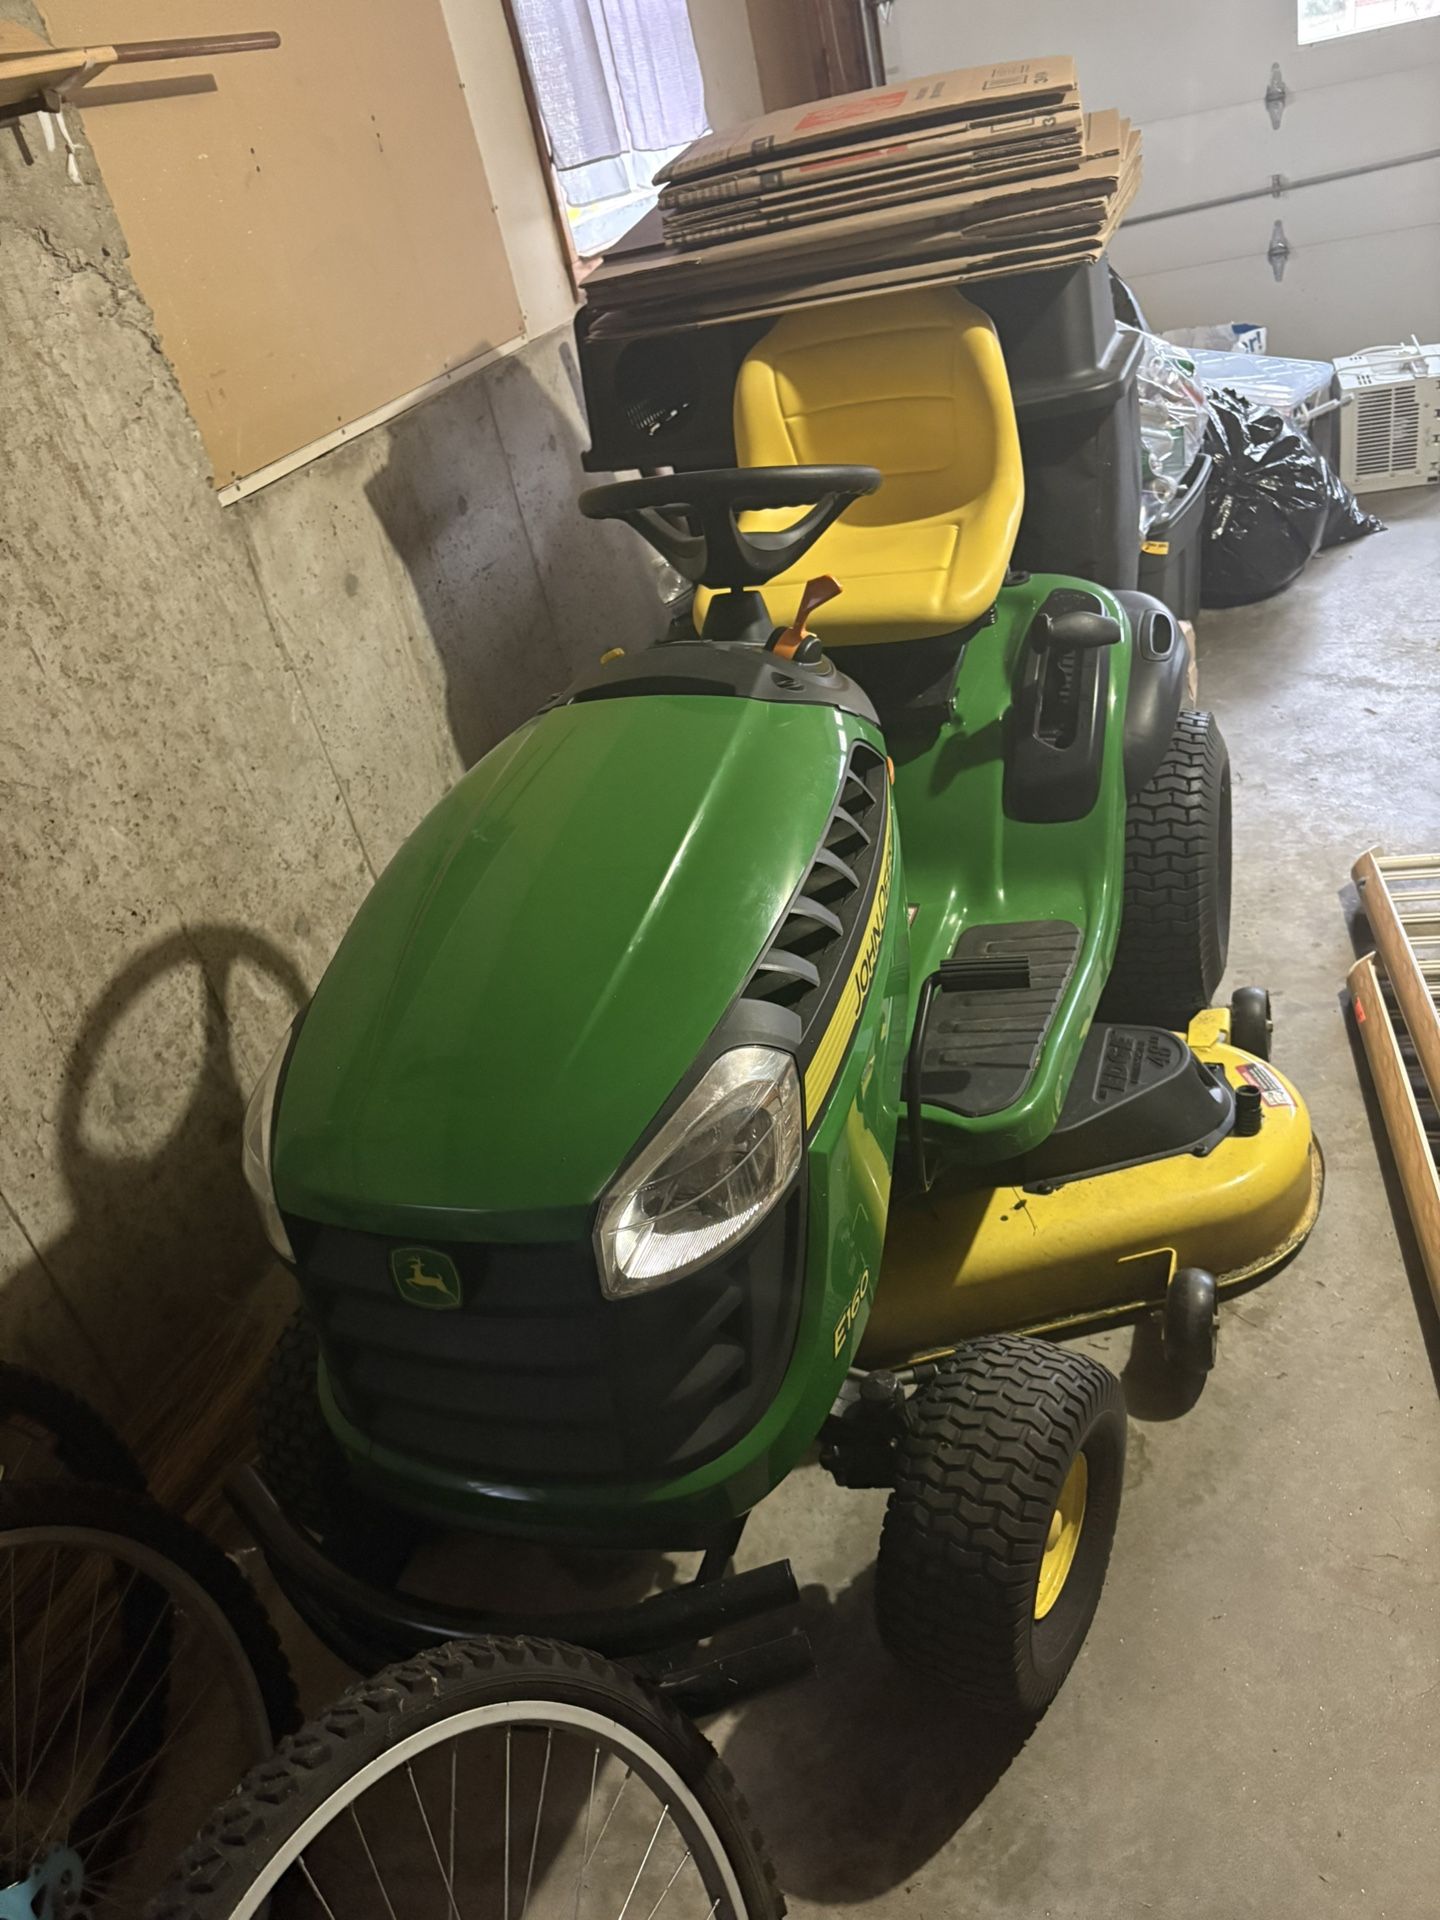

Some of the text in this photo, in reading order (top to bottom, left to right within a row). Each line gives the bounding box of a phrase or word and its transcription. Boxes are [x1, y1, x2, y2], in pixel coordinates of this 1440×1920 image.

[855, 912, 881, 1017] JOHN
[1100, 1036, 1133, 1092] EDGE
[834, 1269, 869, 1358] E160
